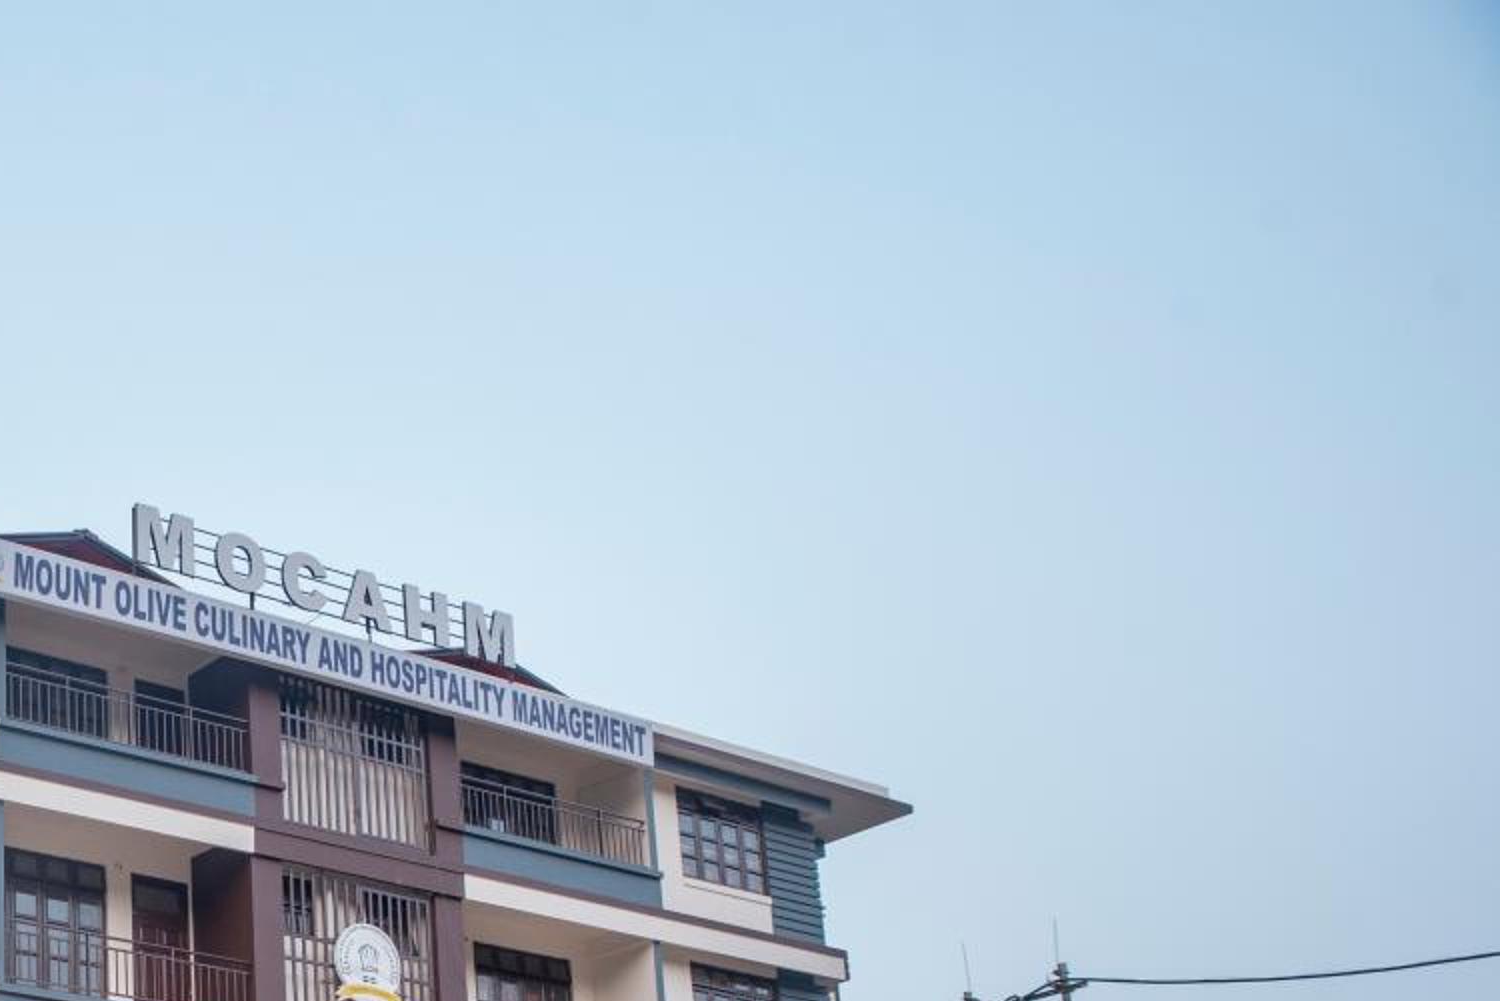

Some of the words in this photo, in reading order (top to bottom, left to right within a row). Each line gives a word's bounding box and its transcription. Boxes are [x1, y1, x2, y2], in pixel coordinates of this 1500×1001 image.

[14, 552, 106, 609] MOUNT
[115, 580, 187, 631] OLIVE
[195, 602, 310, 665] CULINARY
[318, 636, 363, 678] AND
[371, 651, 505, 717] HOSPITALITY
[512, 690, 646, 756] MANAGEMENT
[132, 502, 516, 669] MOCAHM
